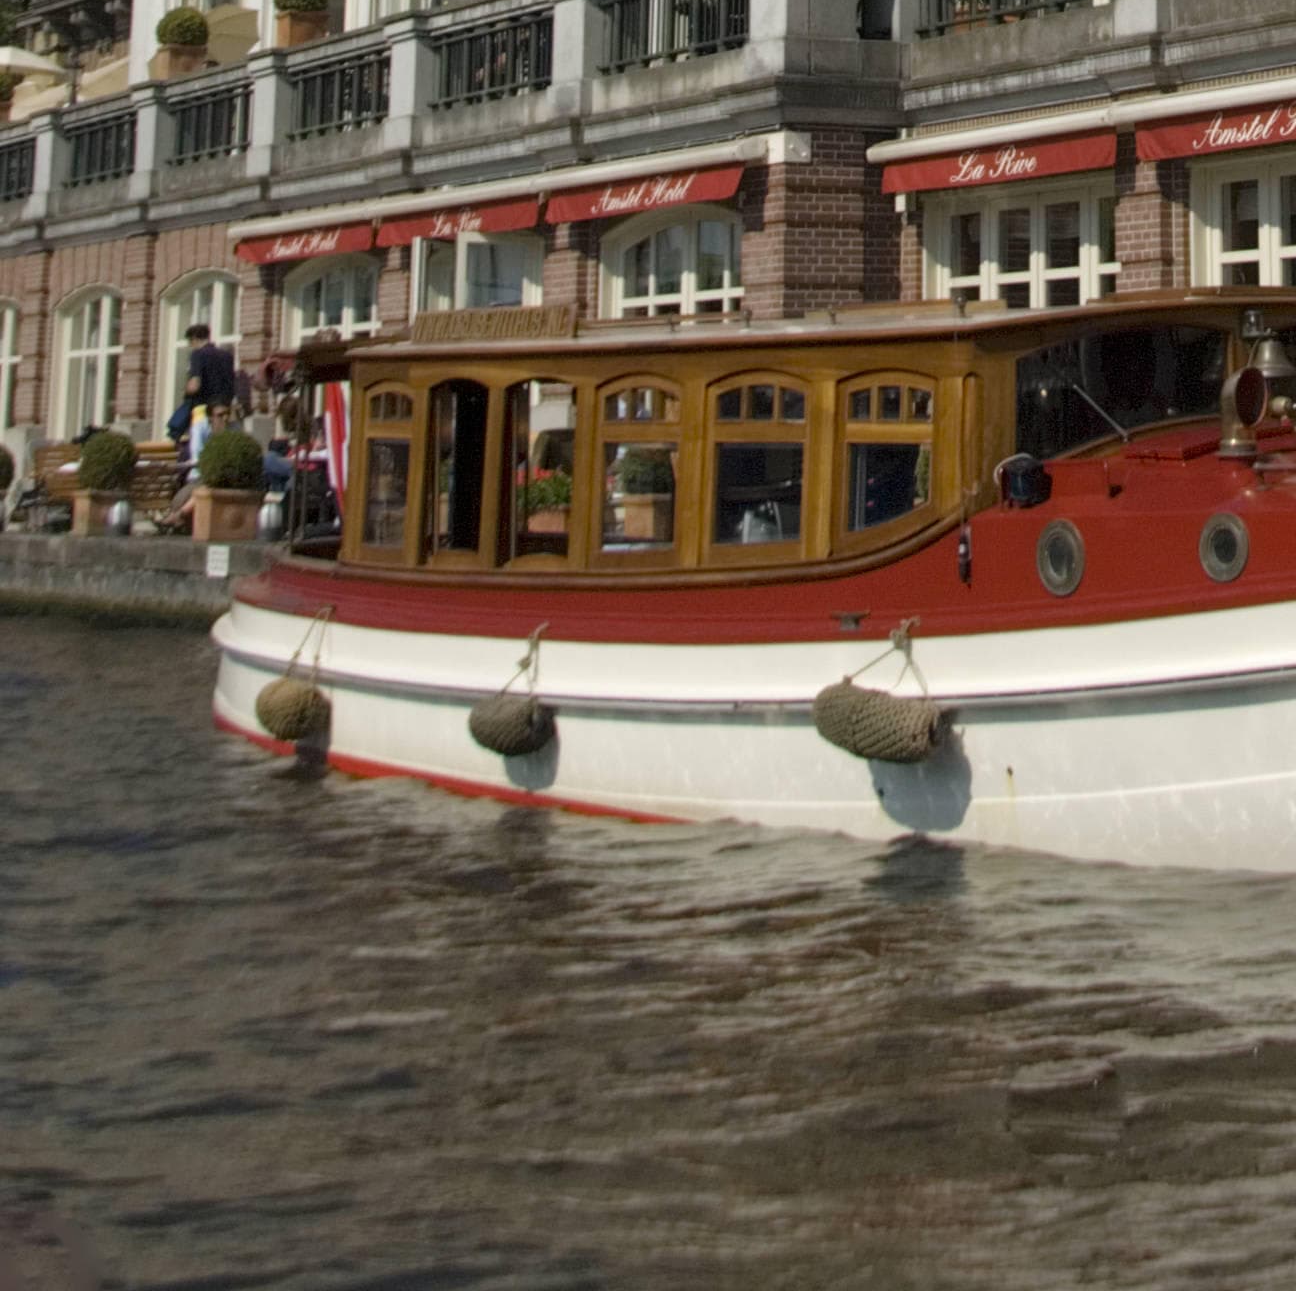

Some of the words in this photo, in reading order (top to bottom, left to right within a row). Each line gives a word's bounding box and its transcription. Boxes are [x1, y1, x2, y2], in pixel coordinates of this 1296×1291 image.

[1192, 108, 1281, 150] Amstel
[949, 148, 985, 184] La
[989, 145, 1038, 178] Rive
